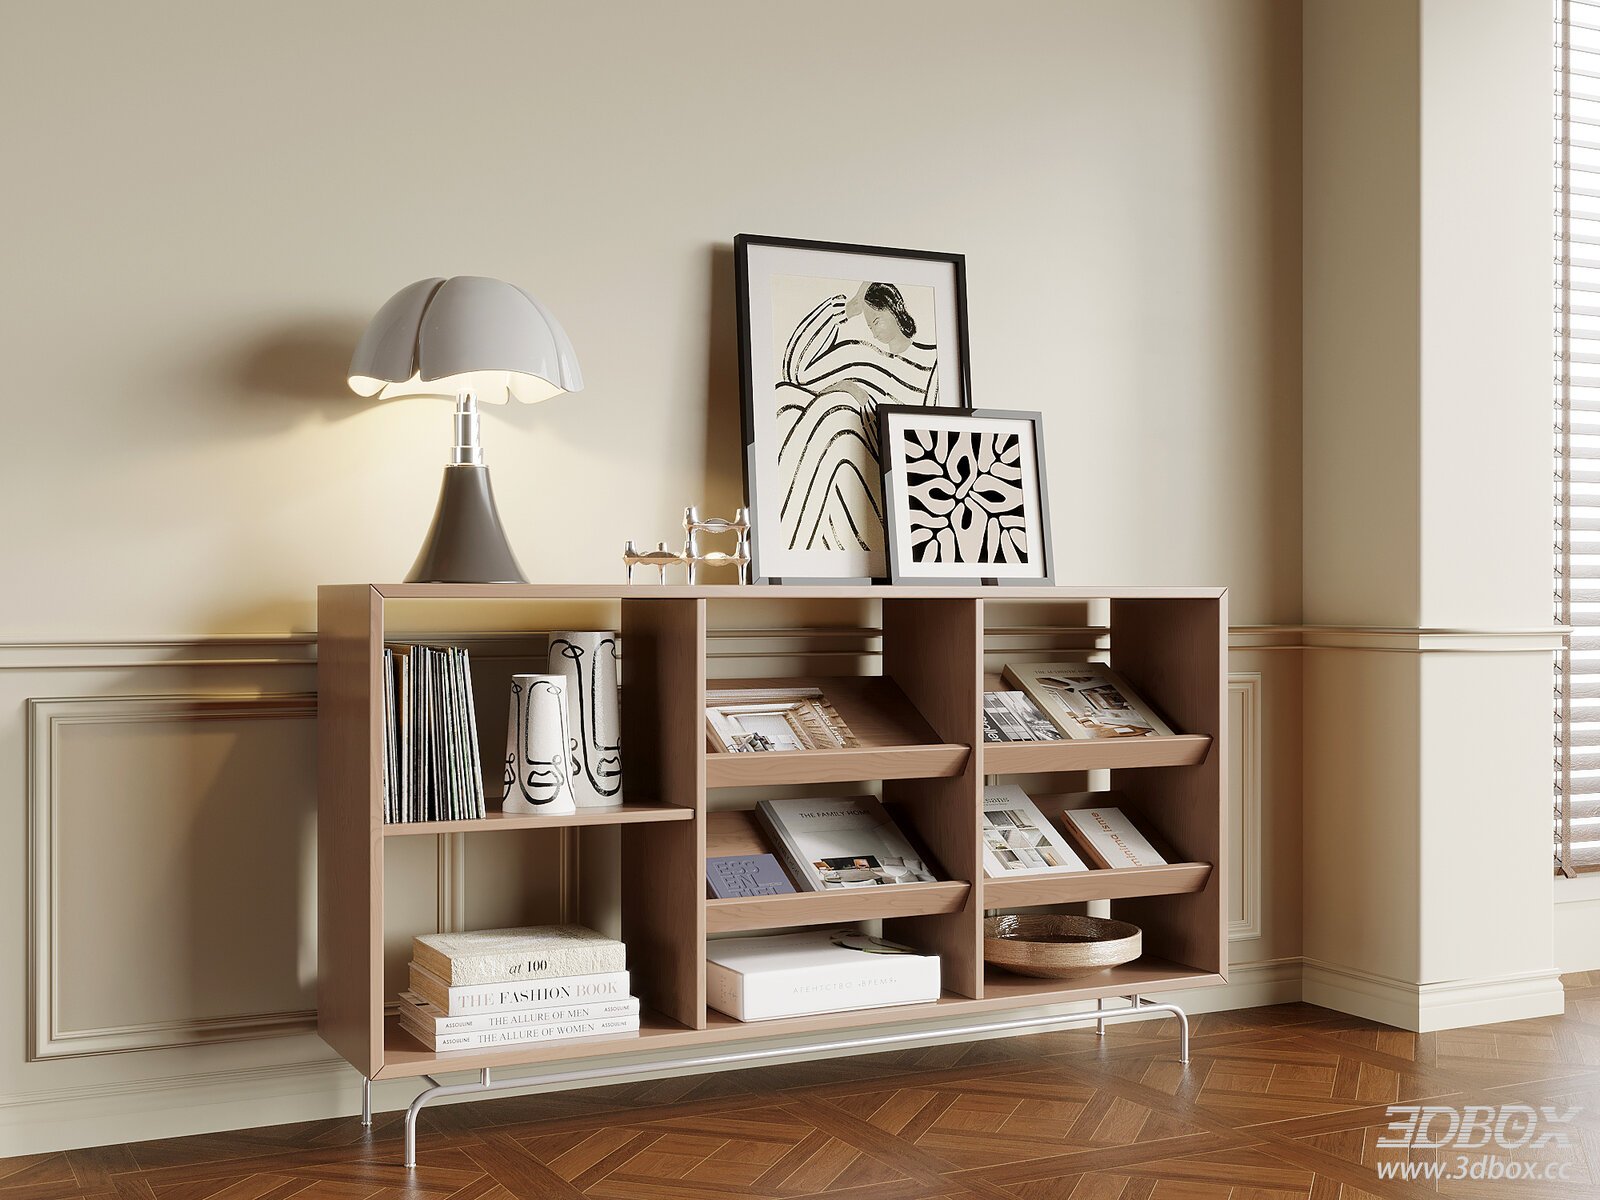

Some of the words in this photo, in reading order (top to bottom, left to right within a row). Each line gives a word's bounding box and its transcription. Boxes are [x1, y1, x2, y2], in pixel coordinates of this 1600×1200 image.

[799, 812, 815, 820] THE
[816, 810, 845, 819] FAMILY
[509, 962, 522, 975] at
[527, 960, 548, 973] 100
[458, 992, 495, 1009] THE
[499, 985, 571, 1005] FASHION
[575, 980, 618, 997] BOOK
[604, 1004, 630, 1013] ASSOULINE
[445, 1020, 473, 1029] ASSOULINE
[489, 1016, 508, 1026] THE
[509, 1012, 550, 1025] ALLURE
[552, 1010, 566, 1021] OF
[567, 1008, 590, 1019] MEN
[601, 1020, 627, 1029] ASSOULINE
[442, 1036, 471, 1045] ASSOULINE
[478, 1033, 498, 1044] THE
[499, 1029, 540, 1042] ALLURE
[541, 1027, 555, 1038] OF
[556, 1023, 595, 1036] WOMEN
